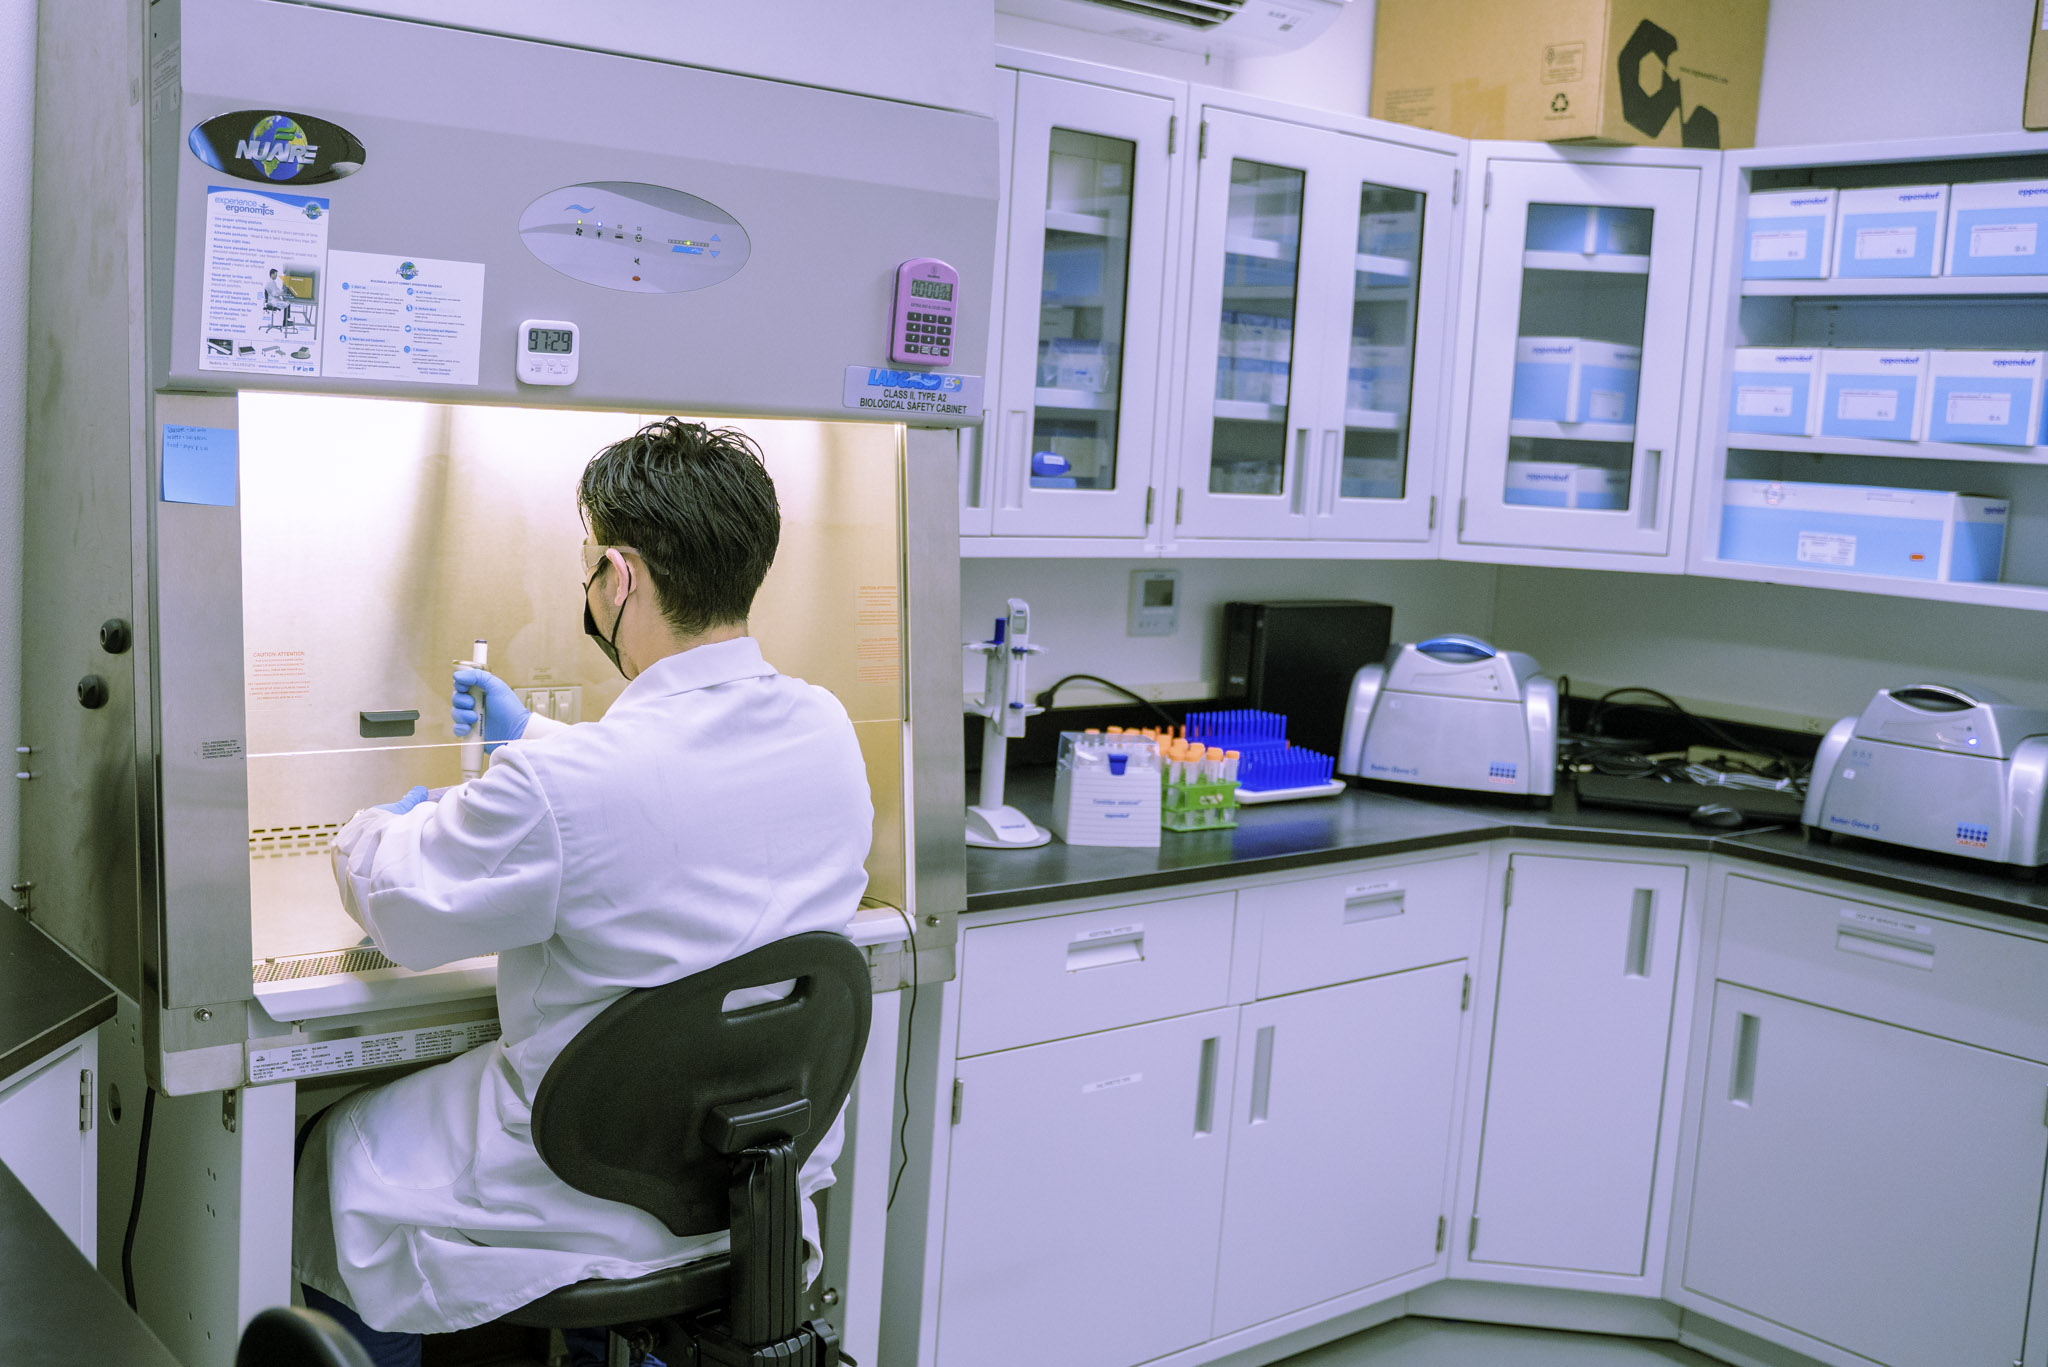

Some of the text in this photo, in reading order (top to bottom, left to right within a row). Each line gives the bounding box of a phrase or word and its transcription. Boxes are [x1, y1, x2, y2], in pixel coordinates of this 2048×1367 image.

[235, 139, 319, 165] NUAIRE
[214, 197, 257, 207] experience
[1790, 197, 1828, 207] eppendorf
[1899, 192, 1939, 203] eppendorf
[225, 203, 274, 216] ergonomics
[1880, 357, 1920, 366] eppendorf
[1992, 358, 2036, 368] eppendorf
[883, 389, 908, 399] CLASS
[918, 392, 936, 401] TYPE
[938, 393, 947, 402] A2
[860, 398, 967, 415] BIOLOGICAL SAFETY CABINET
